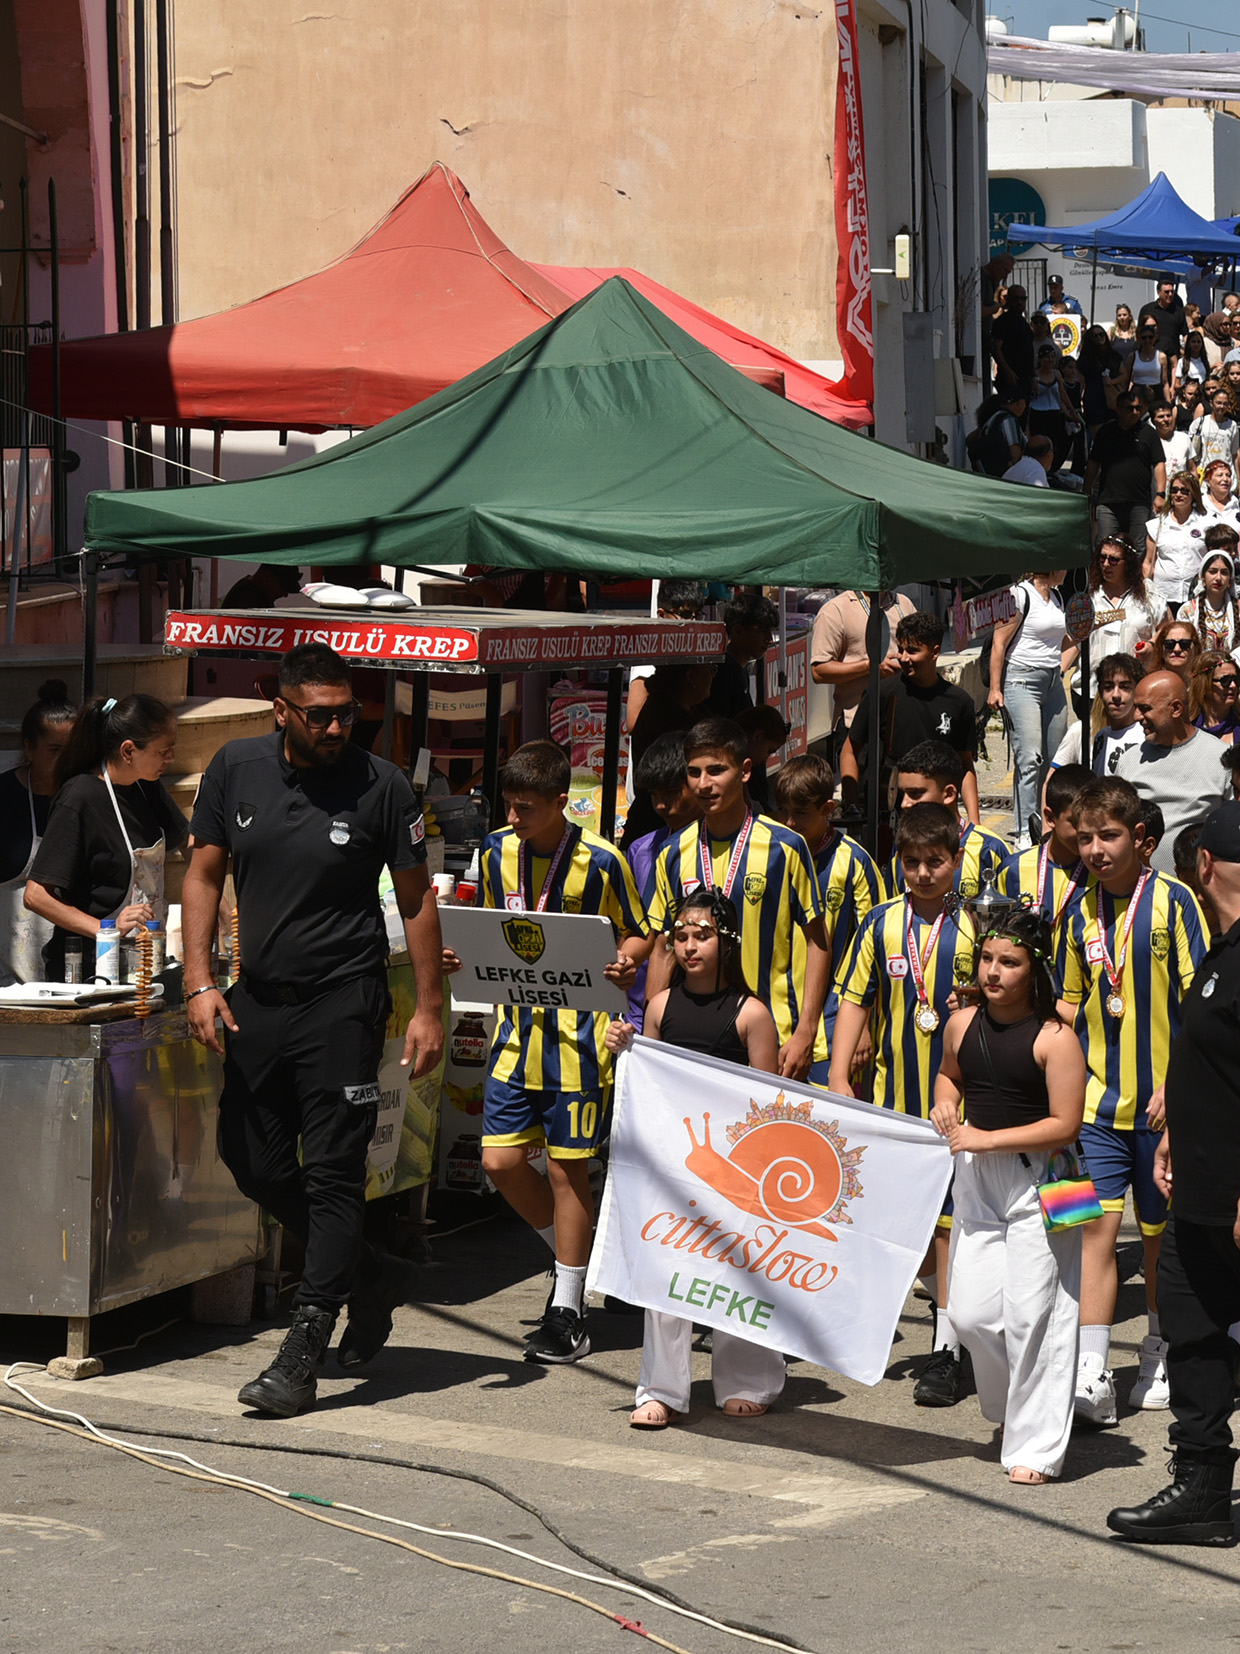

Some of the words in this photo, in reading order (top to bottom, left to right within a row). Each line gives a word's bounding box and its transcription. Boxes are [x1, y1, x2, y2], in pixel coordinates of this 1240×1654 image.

[167, 621, 285, 648] FRANSIZ
[294, 627, 387, 653] USULÜ
[391, 634, 470, 658] KREP
[486, 638, 538, 661] FRANSIZ
[541, 631, 581, 658] USULÜ
[581, 635, 611, 657] KREP
[614, 633, 659, 655] FRANSIZ
[661, 628, 695, 653] USULÜ
[696, 632, 723, 652] KREP
[475, 966, 537, 984] LEFKE
[542, 969, 593, 988] GAZİ
[508, 985, 569, 1006] LİSESİ
[454, 1038, 484, 1048] nutella
[567, 1101, 597, 1138] 10
[449, 1160, 479, 1170] nutella
[668, 1272, 776, 1330] LEFKE
